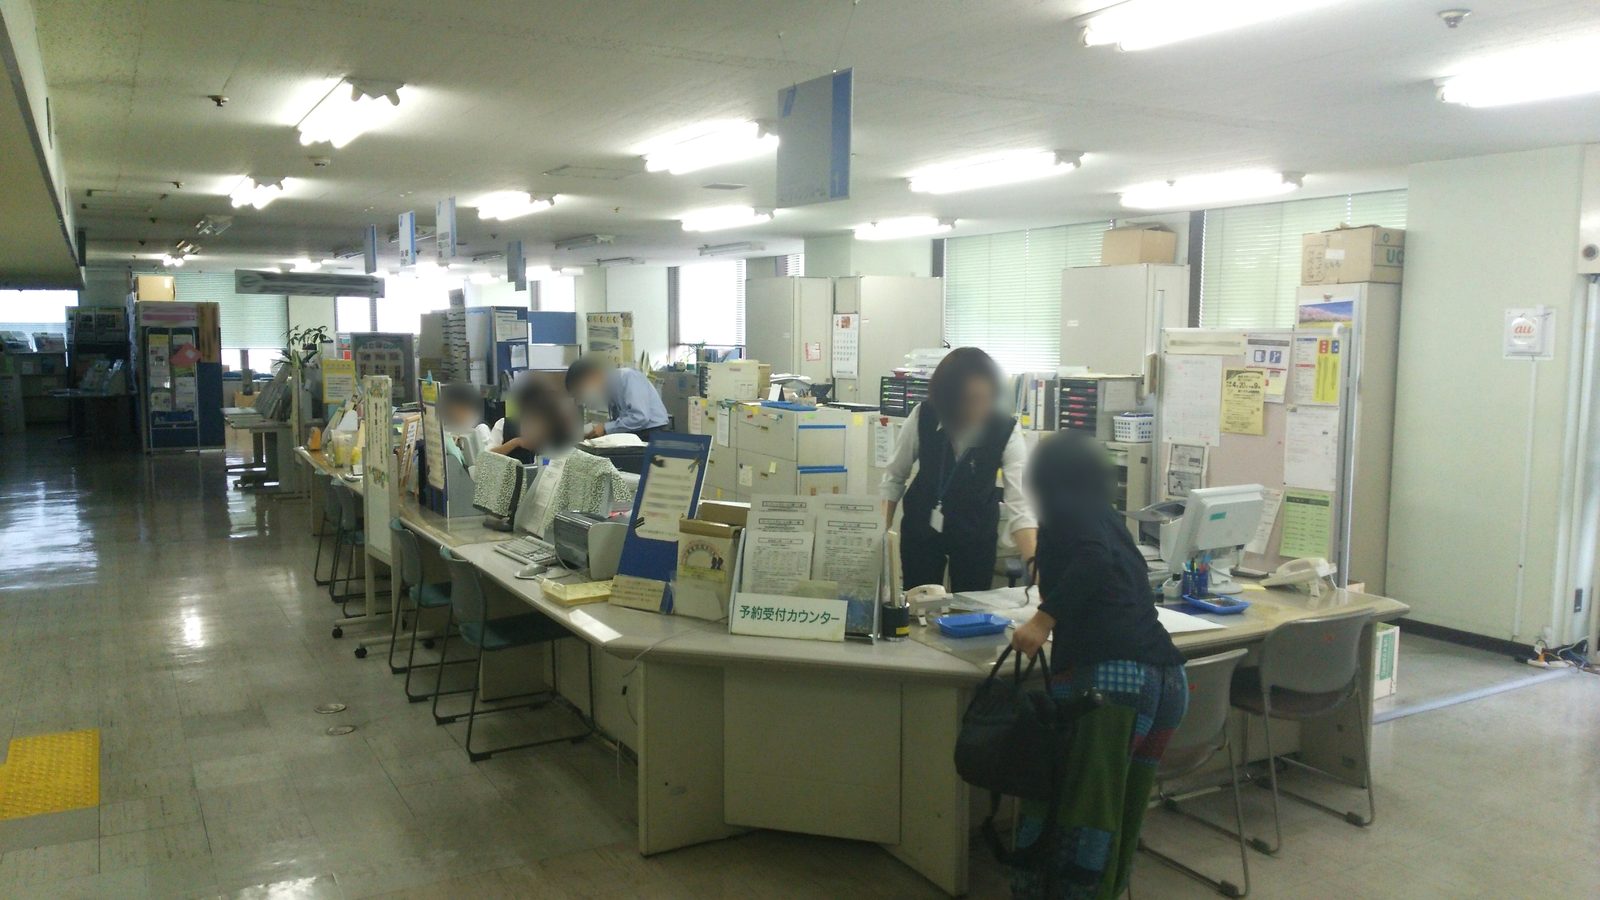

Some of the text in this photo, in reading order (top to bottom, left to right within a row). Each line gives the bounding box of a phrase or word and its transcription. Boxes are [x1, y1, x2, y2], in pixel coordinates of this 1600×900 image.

[739, 604, 840, 625] 予約受付カウンター
